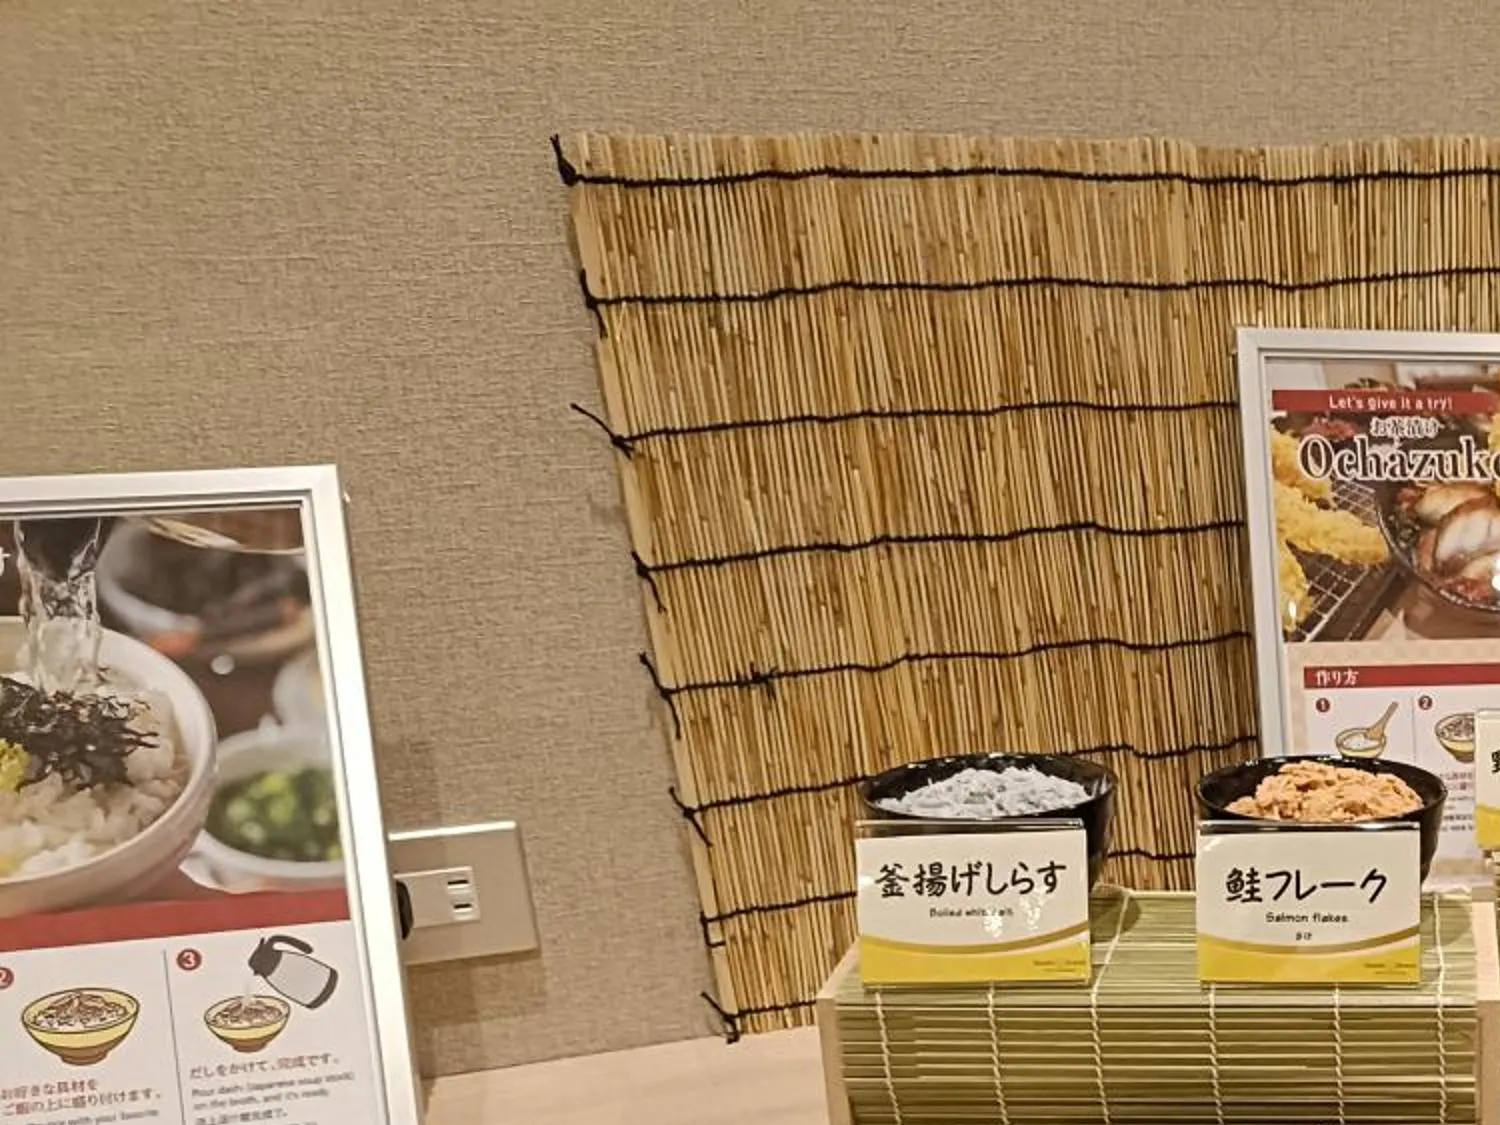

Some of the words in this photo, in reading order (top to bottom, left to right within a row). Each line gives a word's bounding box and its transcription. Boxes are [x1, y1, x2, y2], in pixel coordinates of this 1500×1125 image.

[1329, 395, 1364, 409] Let's
[1368, 396, 1396, 411] give
[1401, 395, 1411, 409] it
[1415, 398, 1423, 409] a
[1427, 396, 1453, 411] try!
[1316, 669, 1359, 686] 作り方
[875, 861, 1067, 898] 釜揚げしらす
[1225, 867, 1387, 903] 鮭フレーク
[1266, 912, 1308, 923] Salmon
[1312, 912, 1348, 923] flakes
